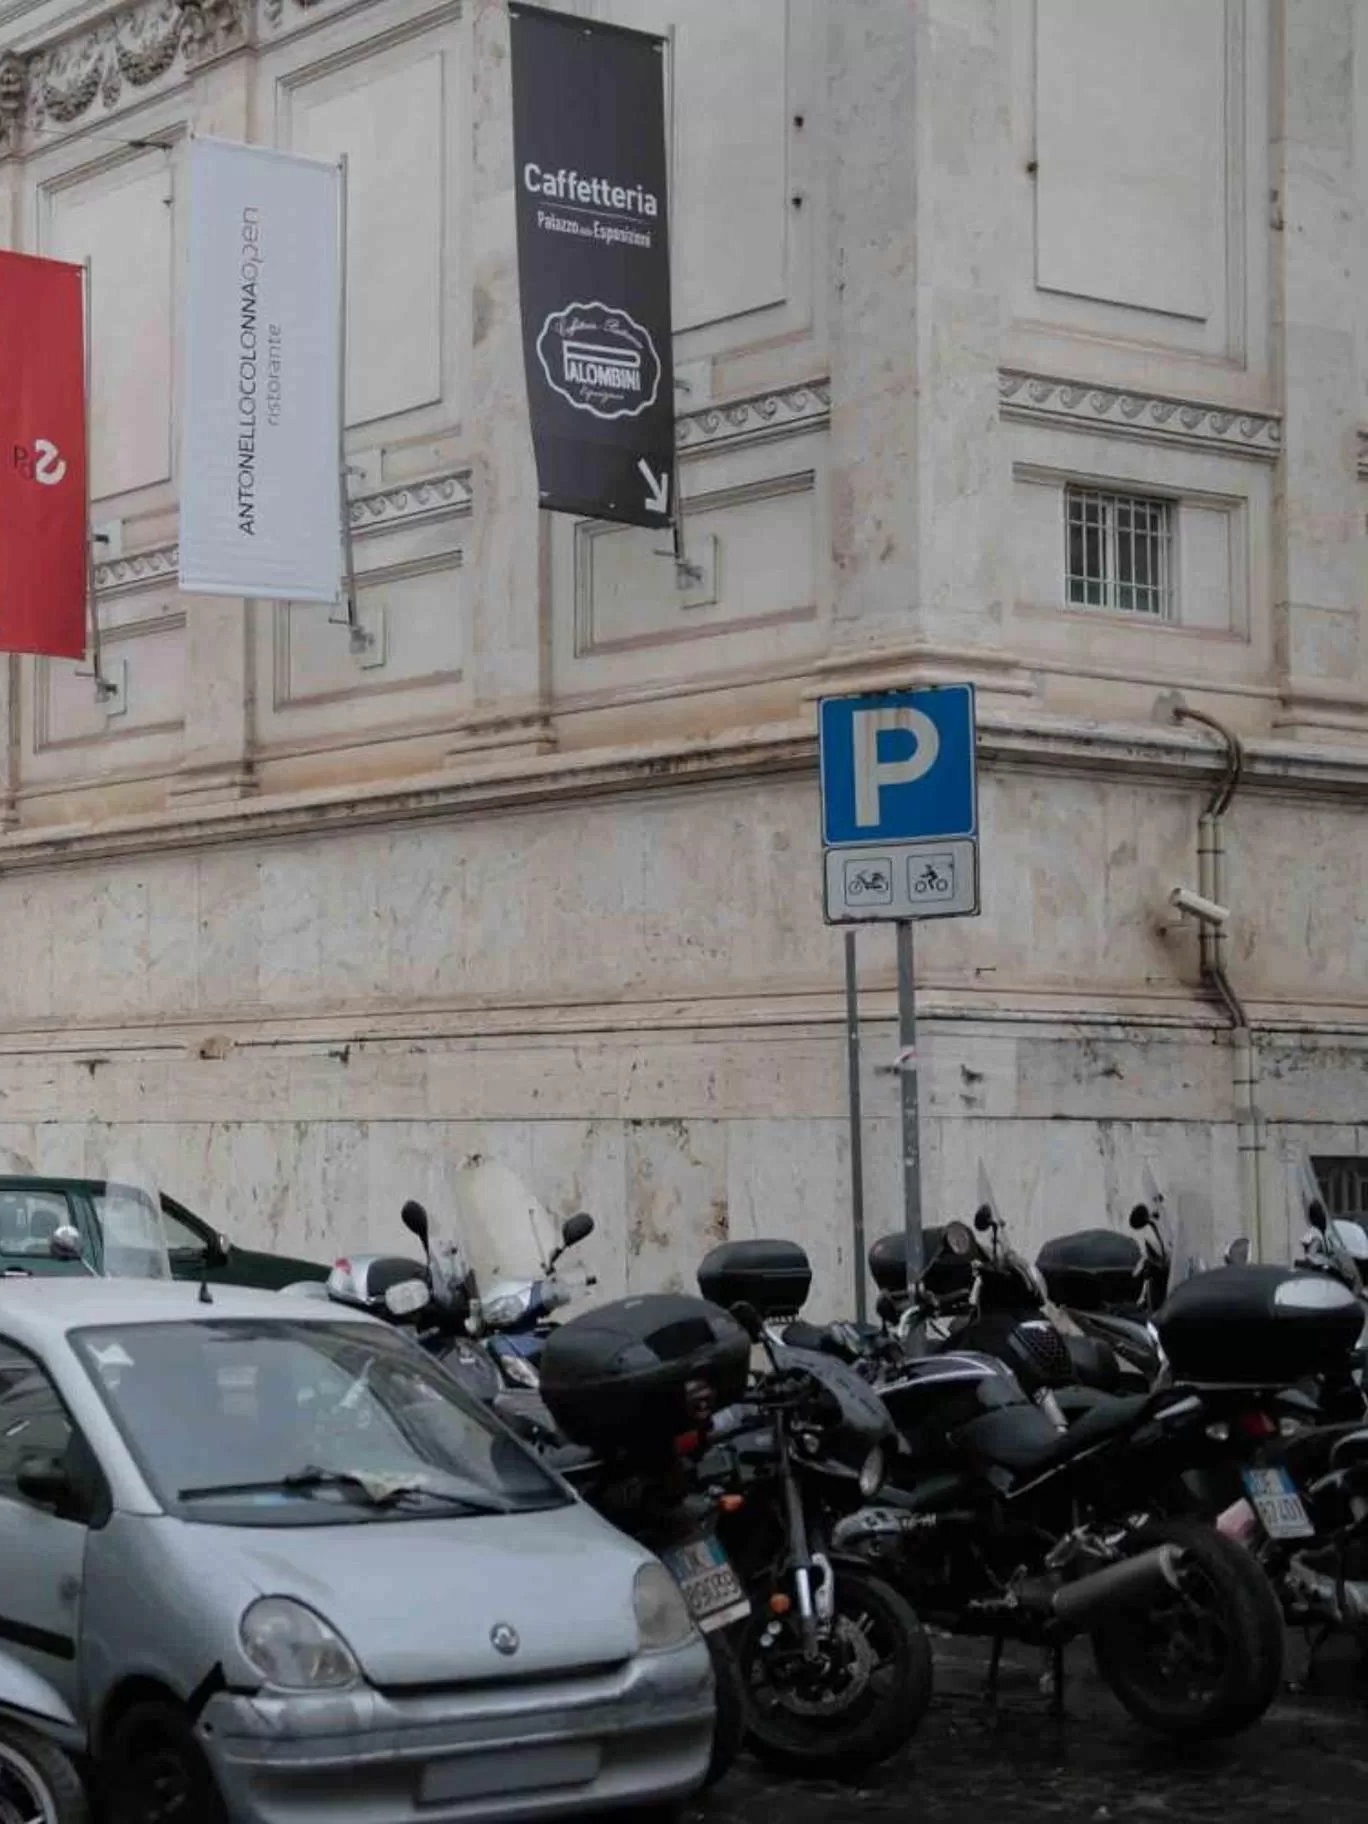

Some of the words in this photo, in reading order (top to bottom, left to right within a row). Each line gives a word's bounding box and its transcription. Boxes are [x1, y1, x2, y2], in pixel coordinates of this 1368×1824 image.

[524, 162, 658, 217] Caffetteria
[267, 322, 283, 426] ristorante
[852, 706, 940, 828] P
